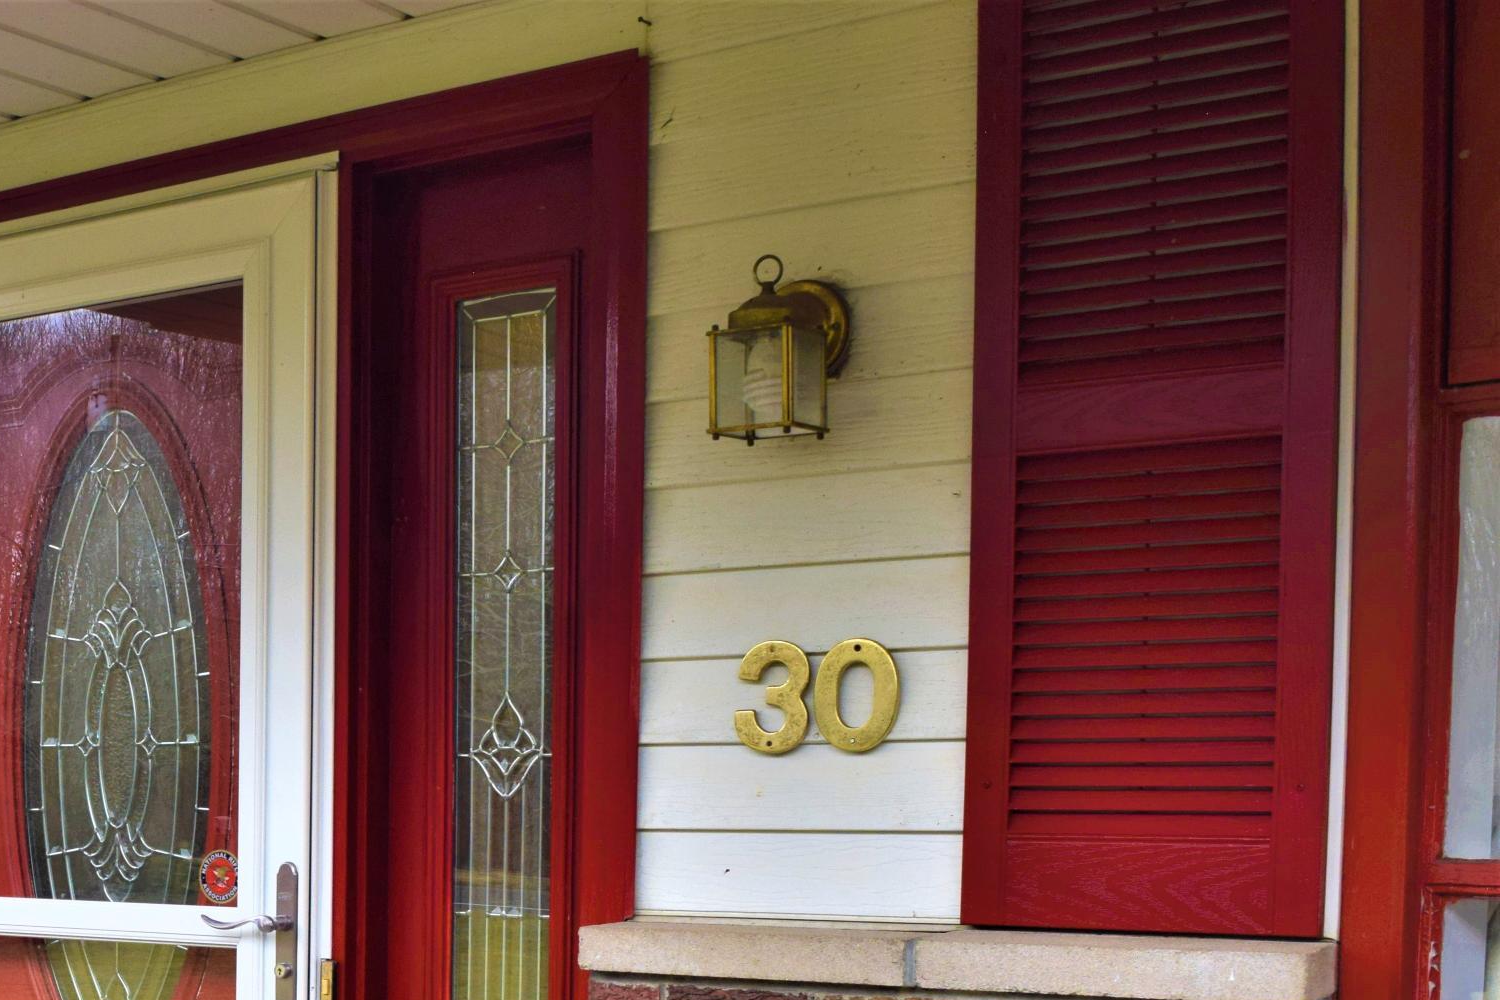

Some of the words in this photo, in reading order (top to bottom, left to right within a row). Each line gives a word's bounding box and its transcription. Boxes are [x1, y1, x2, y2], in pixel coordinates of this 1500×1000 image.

[734, 638, 899, 755] 30
[201, 852, 227, 874] NATIONAL
[202, 884, 238, 901] ASSOCIATION
